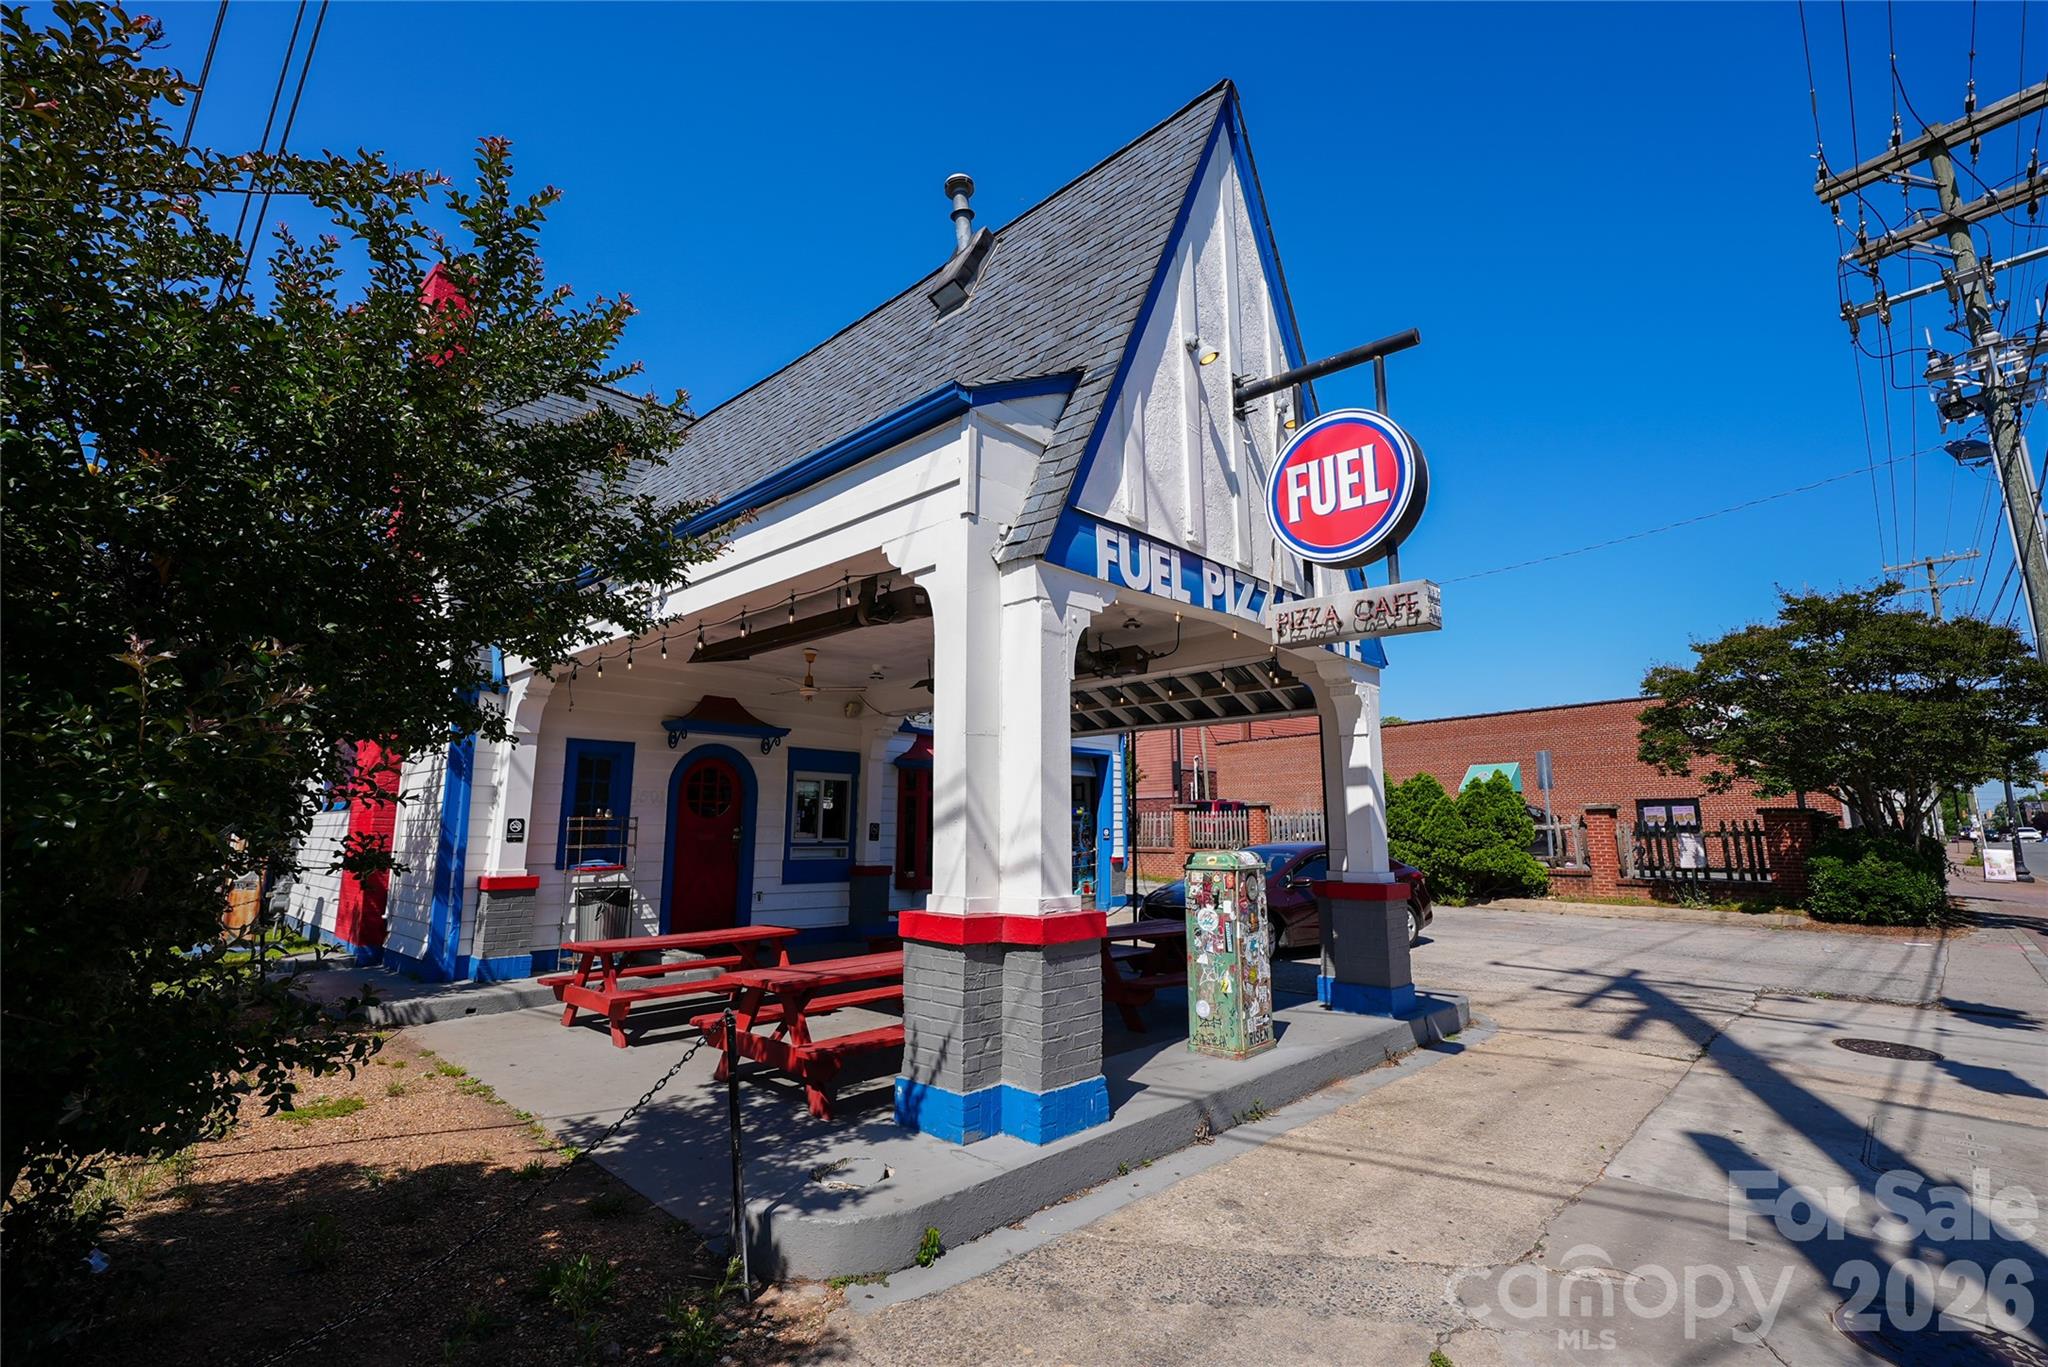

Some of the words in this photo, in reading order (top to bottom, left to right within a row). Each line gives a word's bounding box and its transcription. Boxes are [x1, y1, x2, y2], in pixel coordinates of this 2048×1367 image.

[1285, 443, 1391, 524] FUEL
[1095, 523, 1191, 604] FUEL
[1275, 604, 1340, 634] PIZZA
[1354, 590, 1419, 621] CAFE
